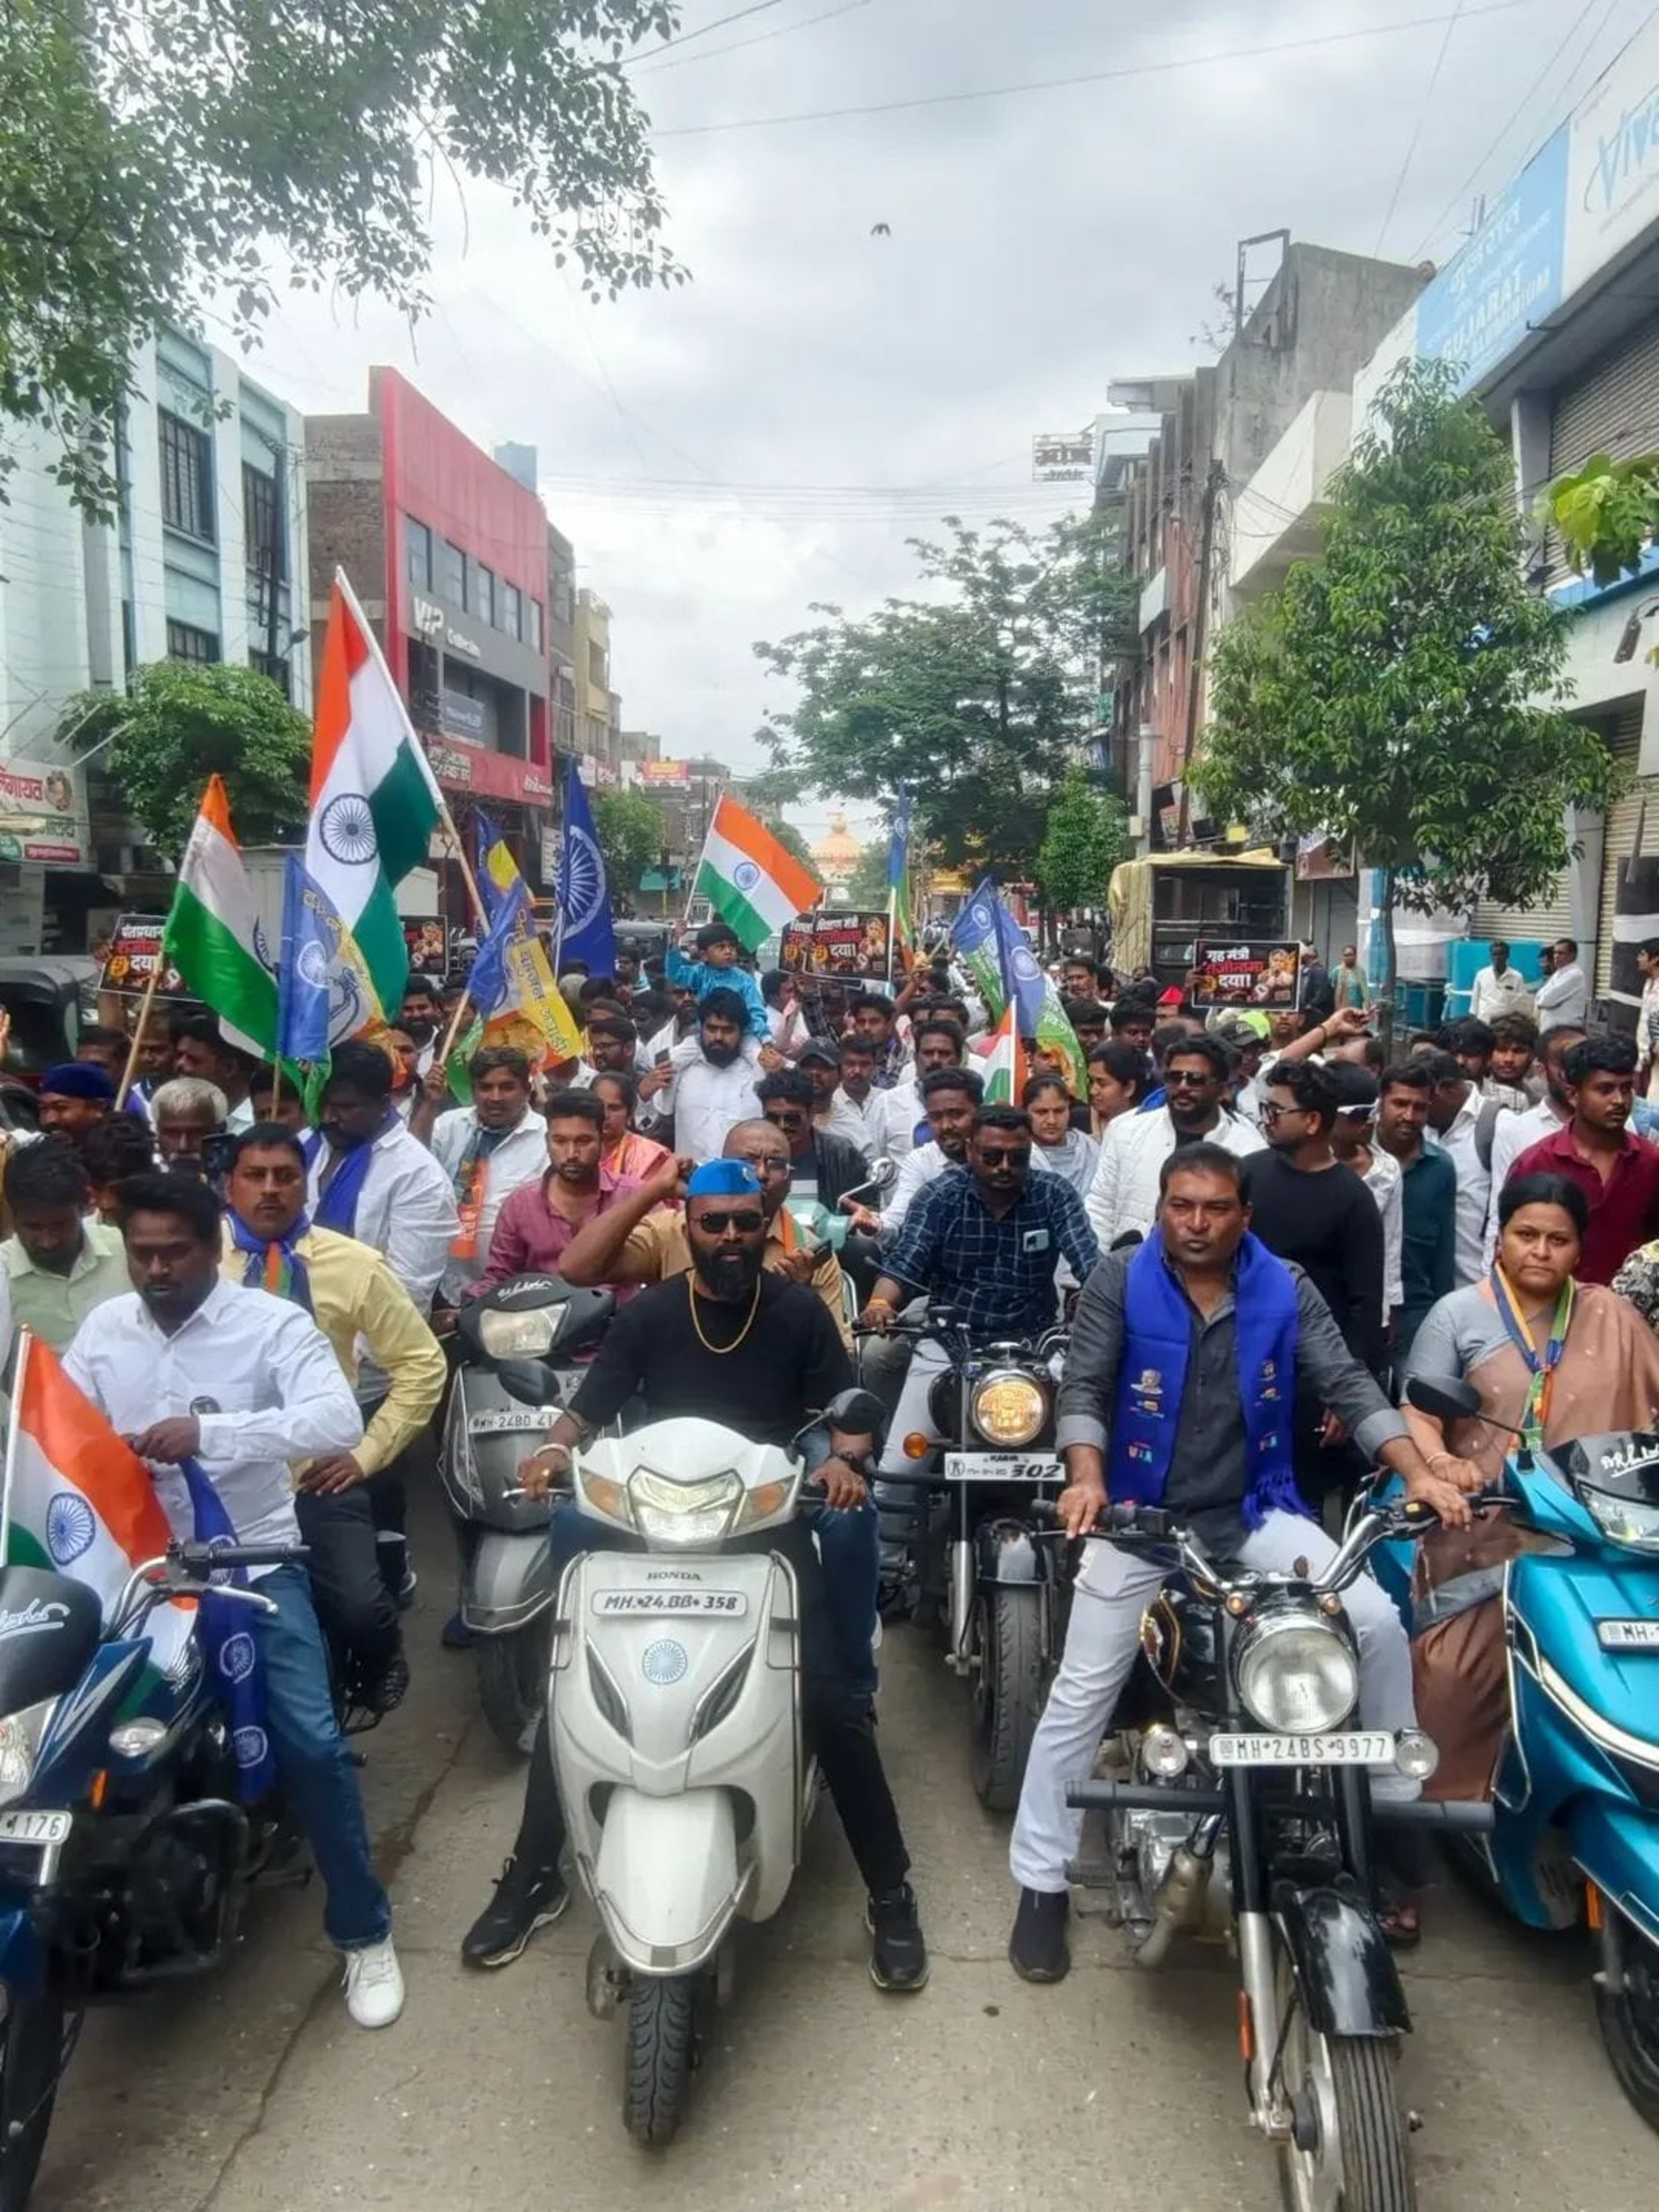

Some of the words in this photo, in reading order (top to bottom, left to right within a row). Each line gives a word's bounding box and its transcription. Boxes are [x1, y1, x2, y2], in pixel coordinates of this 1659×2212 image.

[414, 597, 444, 635] VIP
[1011, 1464, 1061, 1479] 302
[647, 1572, 701, 1581] HONDA
[703, 1595, 737, 1610] 358
[1237, 1740, 1261, 1759] MH
[1333, 1737, 1386, 1758] 9977
